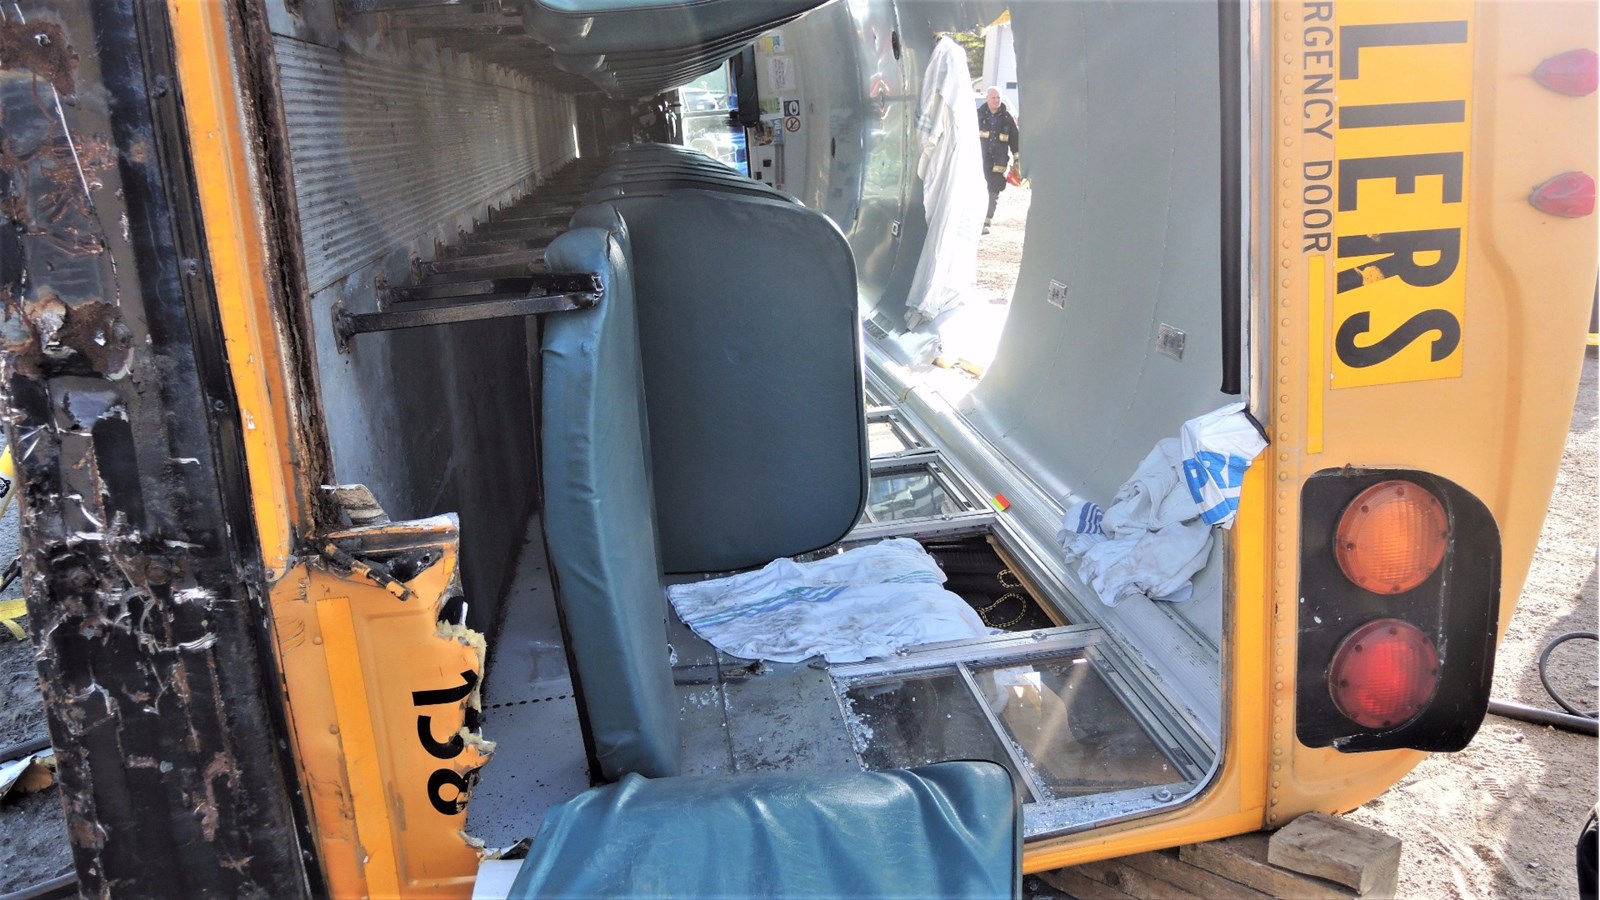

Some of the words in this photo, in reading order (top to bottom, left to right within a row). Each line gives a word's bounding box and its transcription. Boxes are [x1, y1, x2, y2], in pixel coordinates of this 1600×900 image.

[1303, 1, 1333, 140] RGENCY
[1303, 160, 1333, 252] DOOR
[1335, 20, 1467, 368] LIERS
